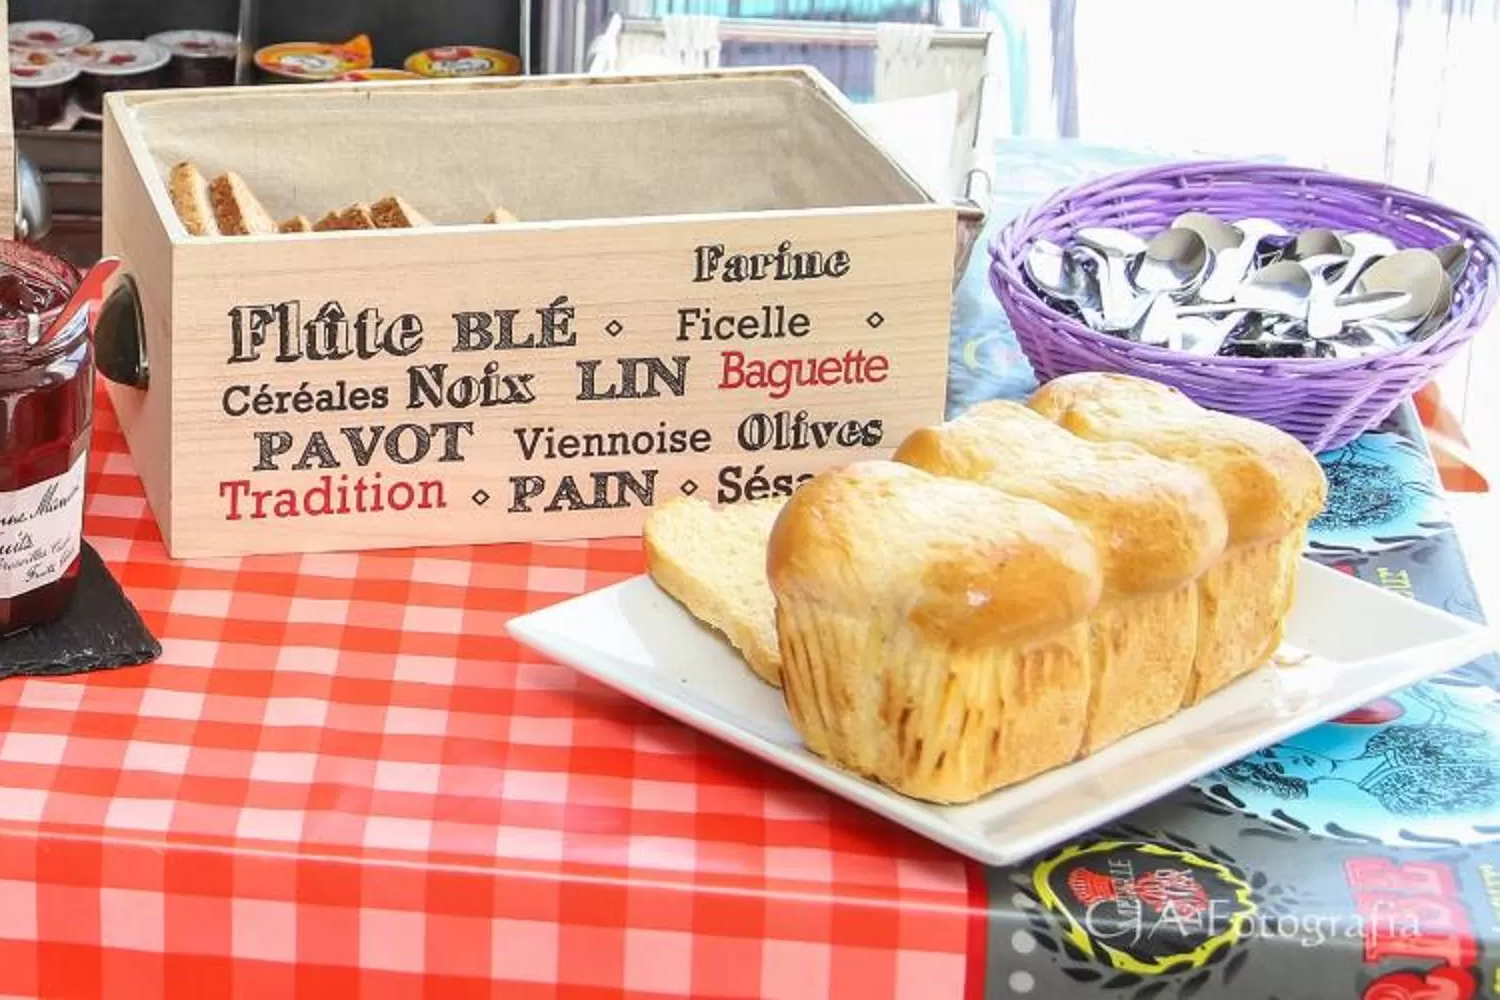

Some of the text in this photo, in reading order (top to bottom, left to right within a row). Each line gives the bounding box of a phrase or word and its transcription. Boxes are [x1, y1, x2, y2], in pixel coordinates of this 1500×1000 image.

[691, 240, 852, 284] Farine
[227, 295, 811, 365] Flûte BLÉ Ficelle
[222, 348, 890, 417] Céréales Noix LIN Baguette
[253, 410, 885, 473] PAVOT Viennoise Olives
[219, 465, 816, 522] Tradition PAIN Sésa
